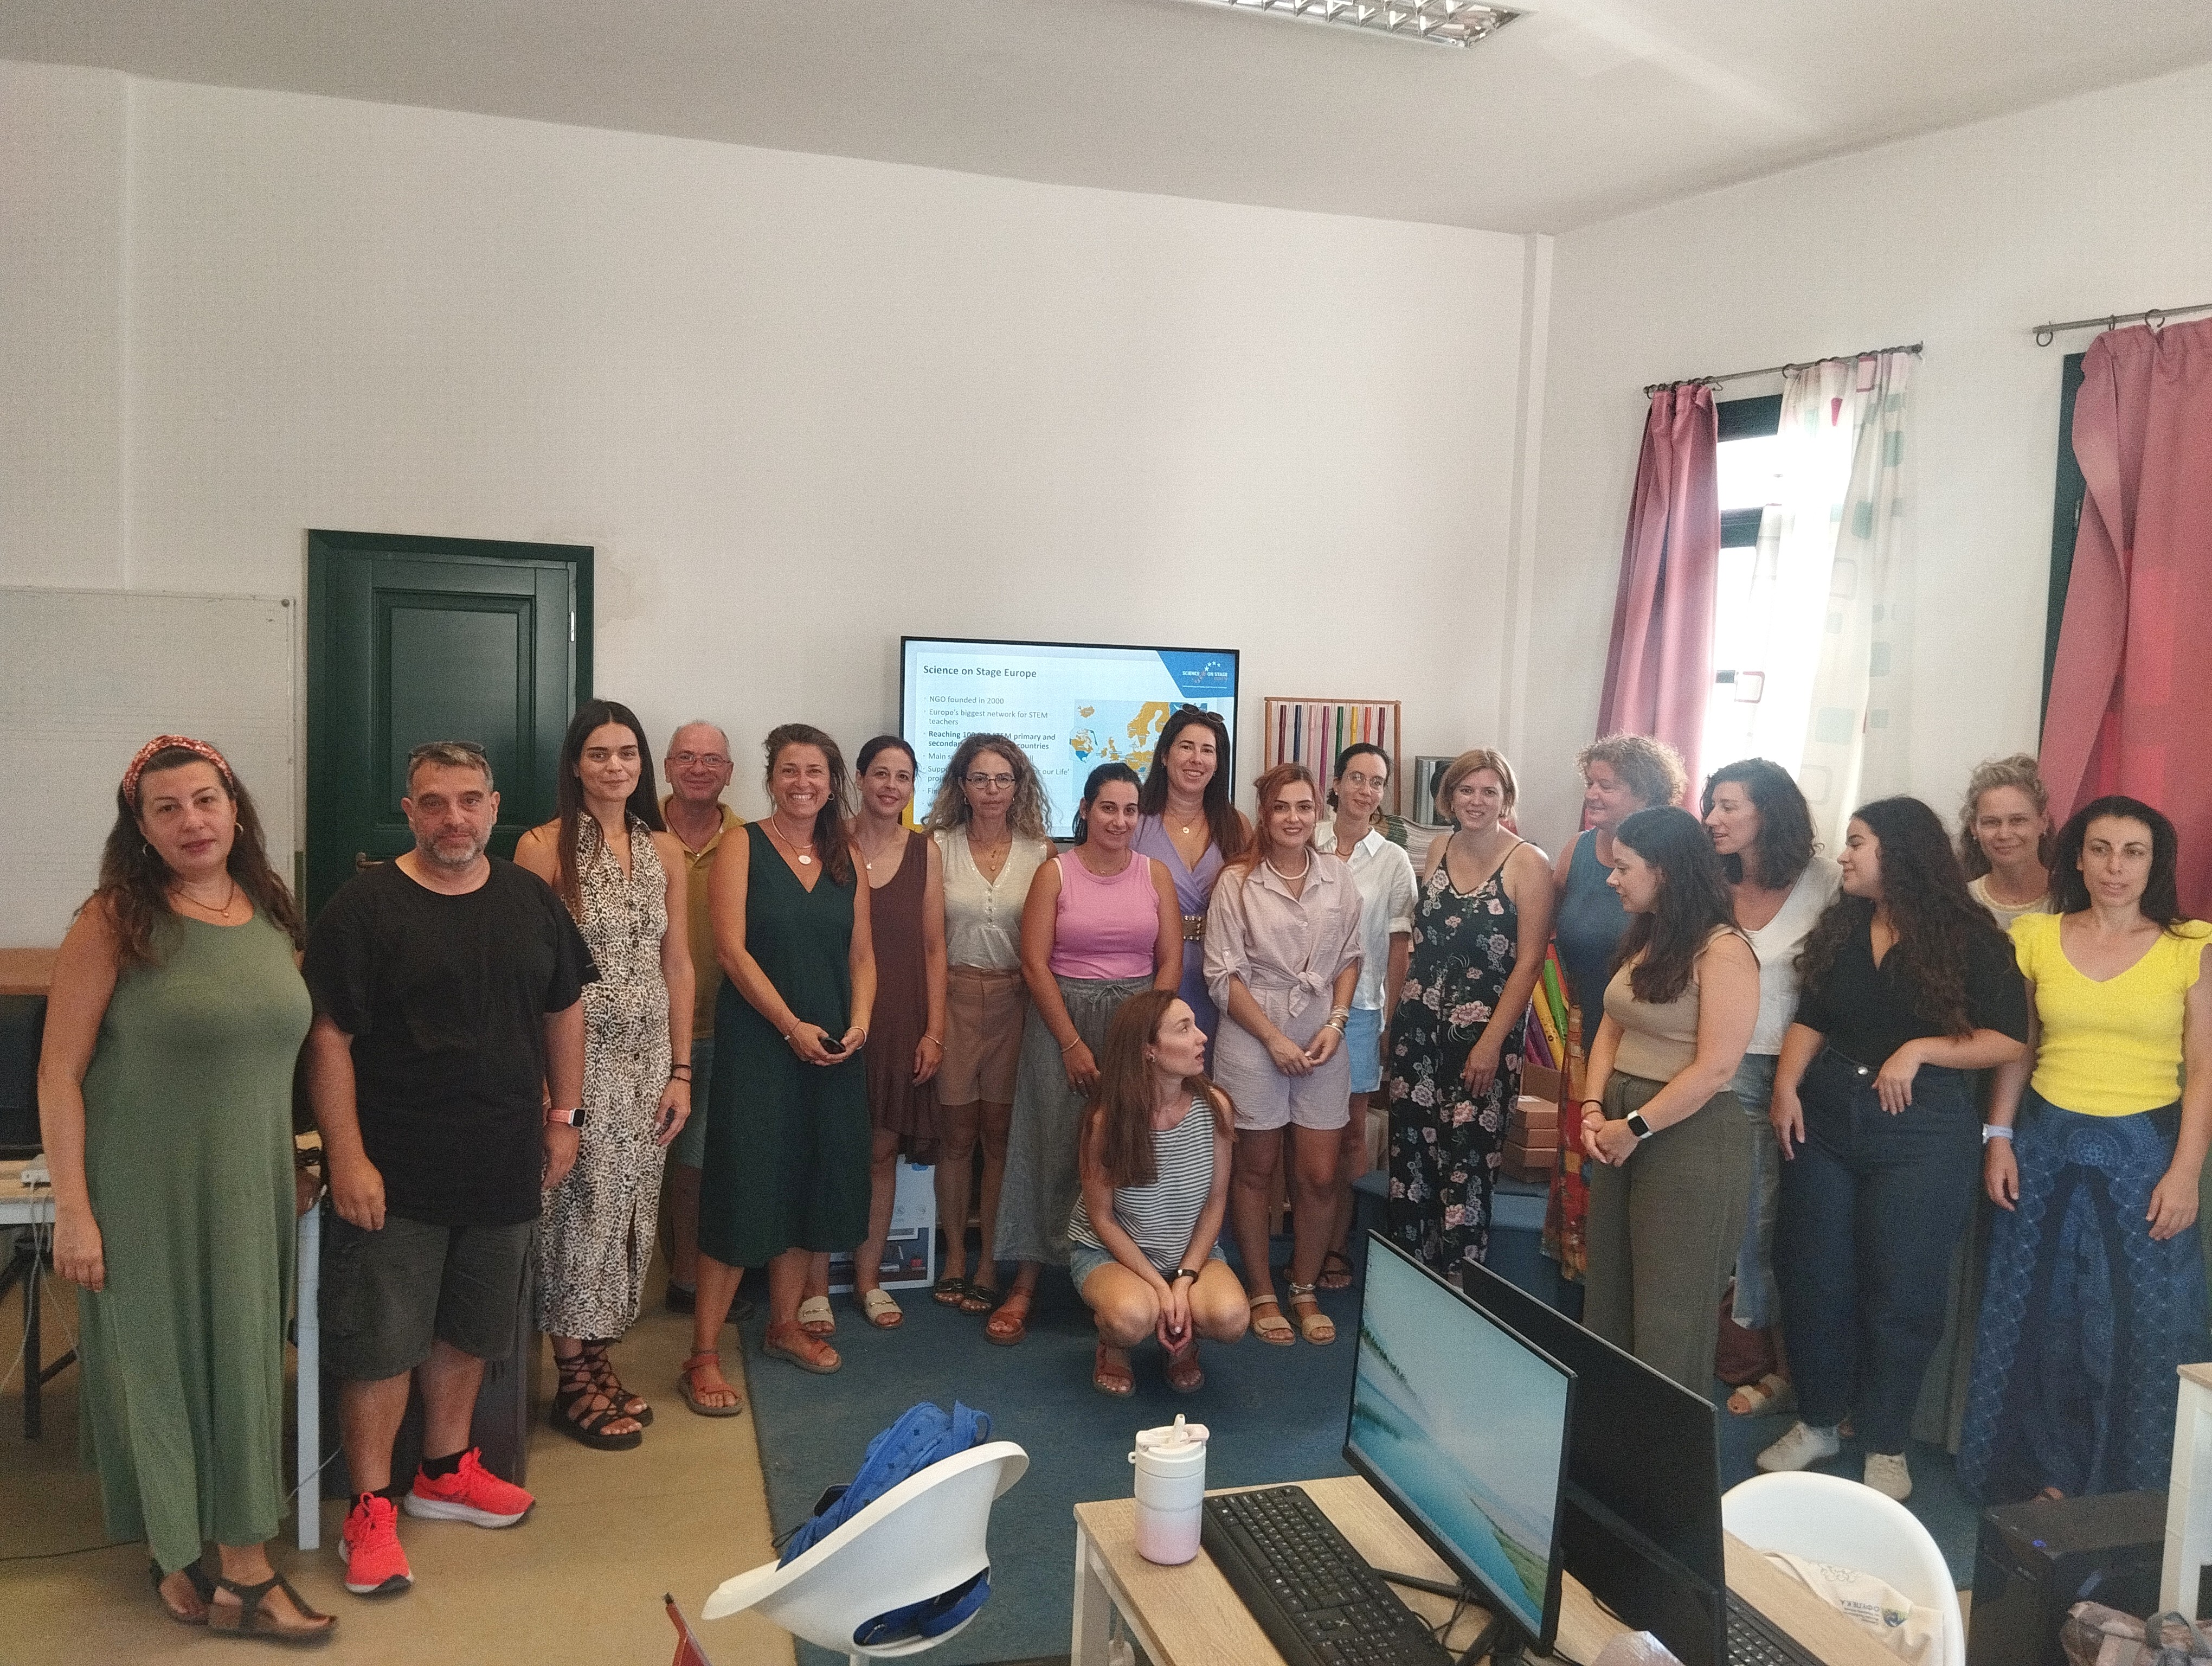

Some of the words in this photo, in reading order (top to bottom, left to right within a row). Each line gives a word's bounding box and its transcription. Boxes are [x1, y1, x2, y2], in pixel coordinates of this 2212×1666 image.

[923, 665, 959, 675] Science
[976, 668, 1001, 678] Stage
[1004, 669, 1037, 679] Europe
[961, 709, 985, 717] biggest
[929, 731, 961, 739] Reaching
[1013, 733, 1041, 741] primary
